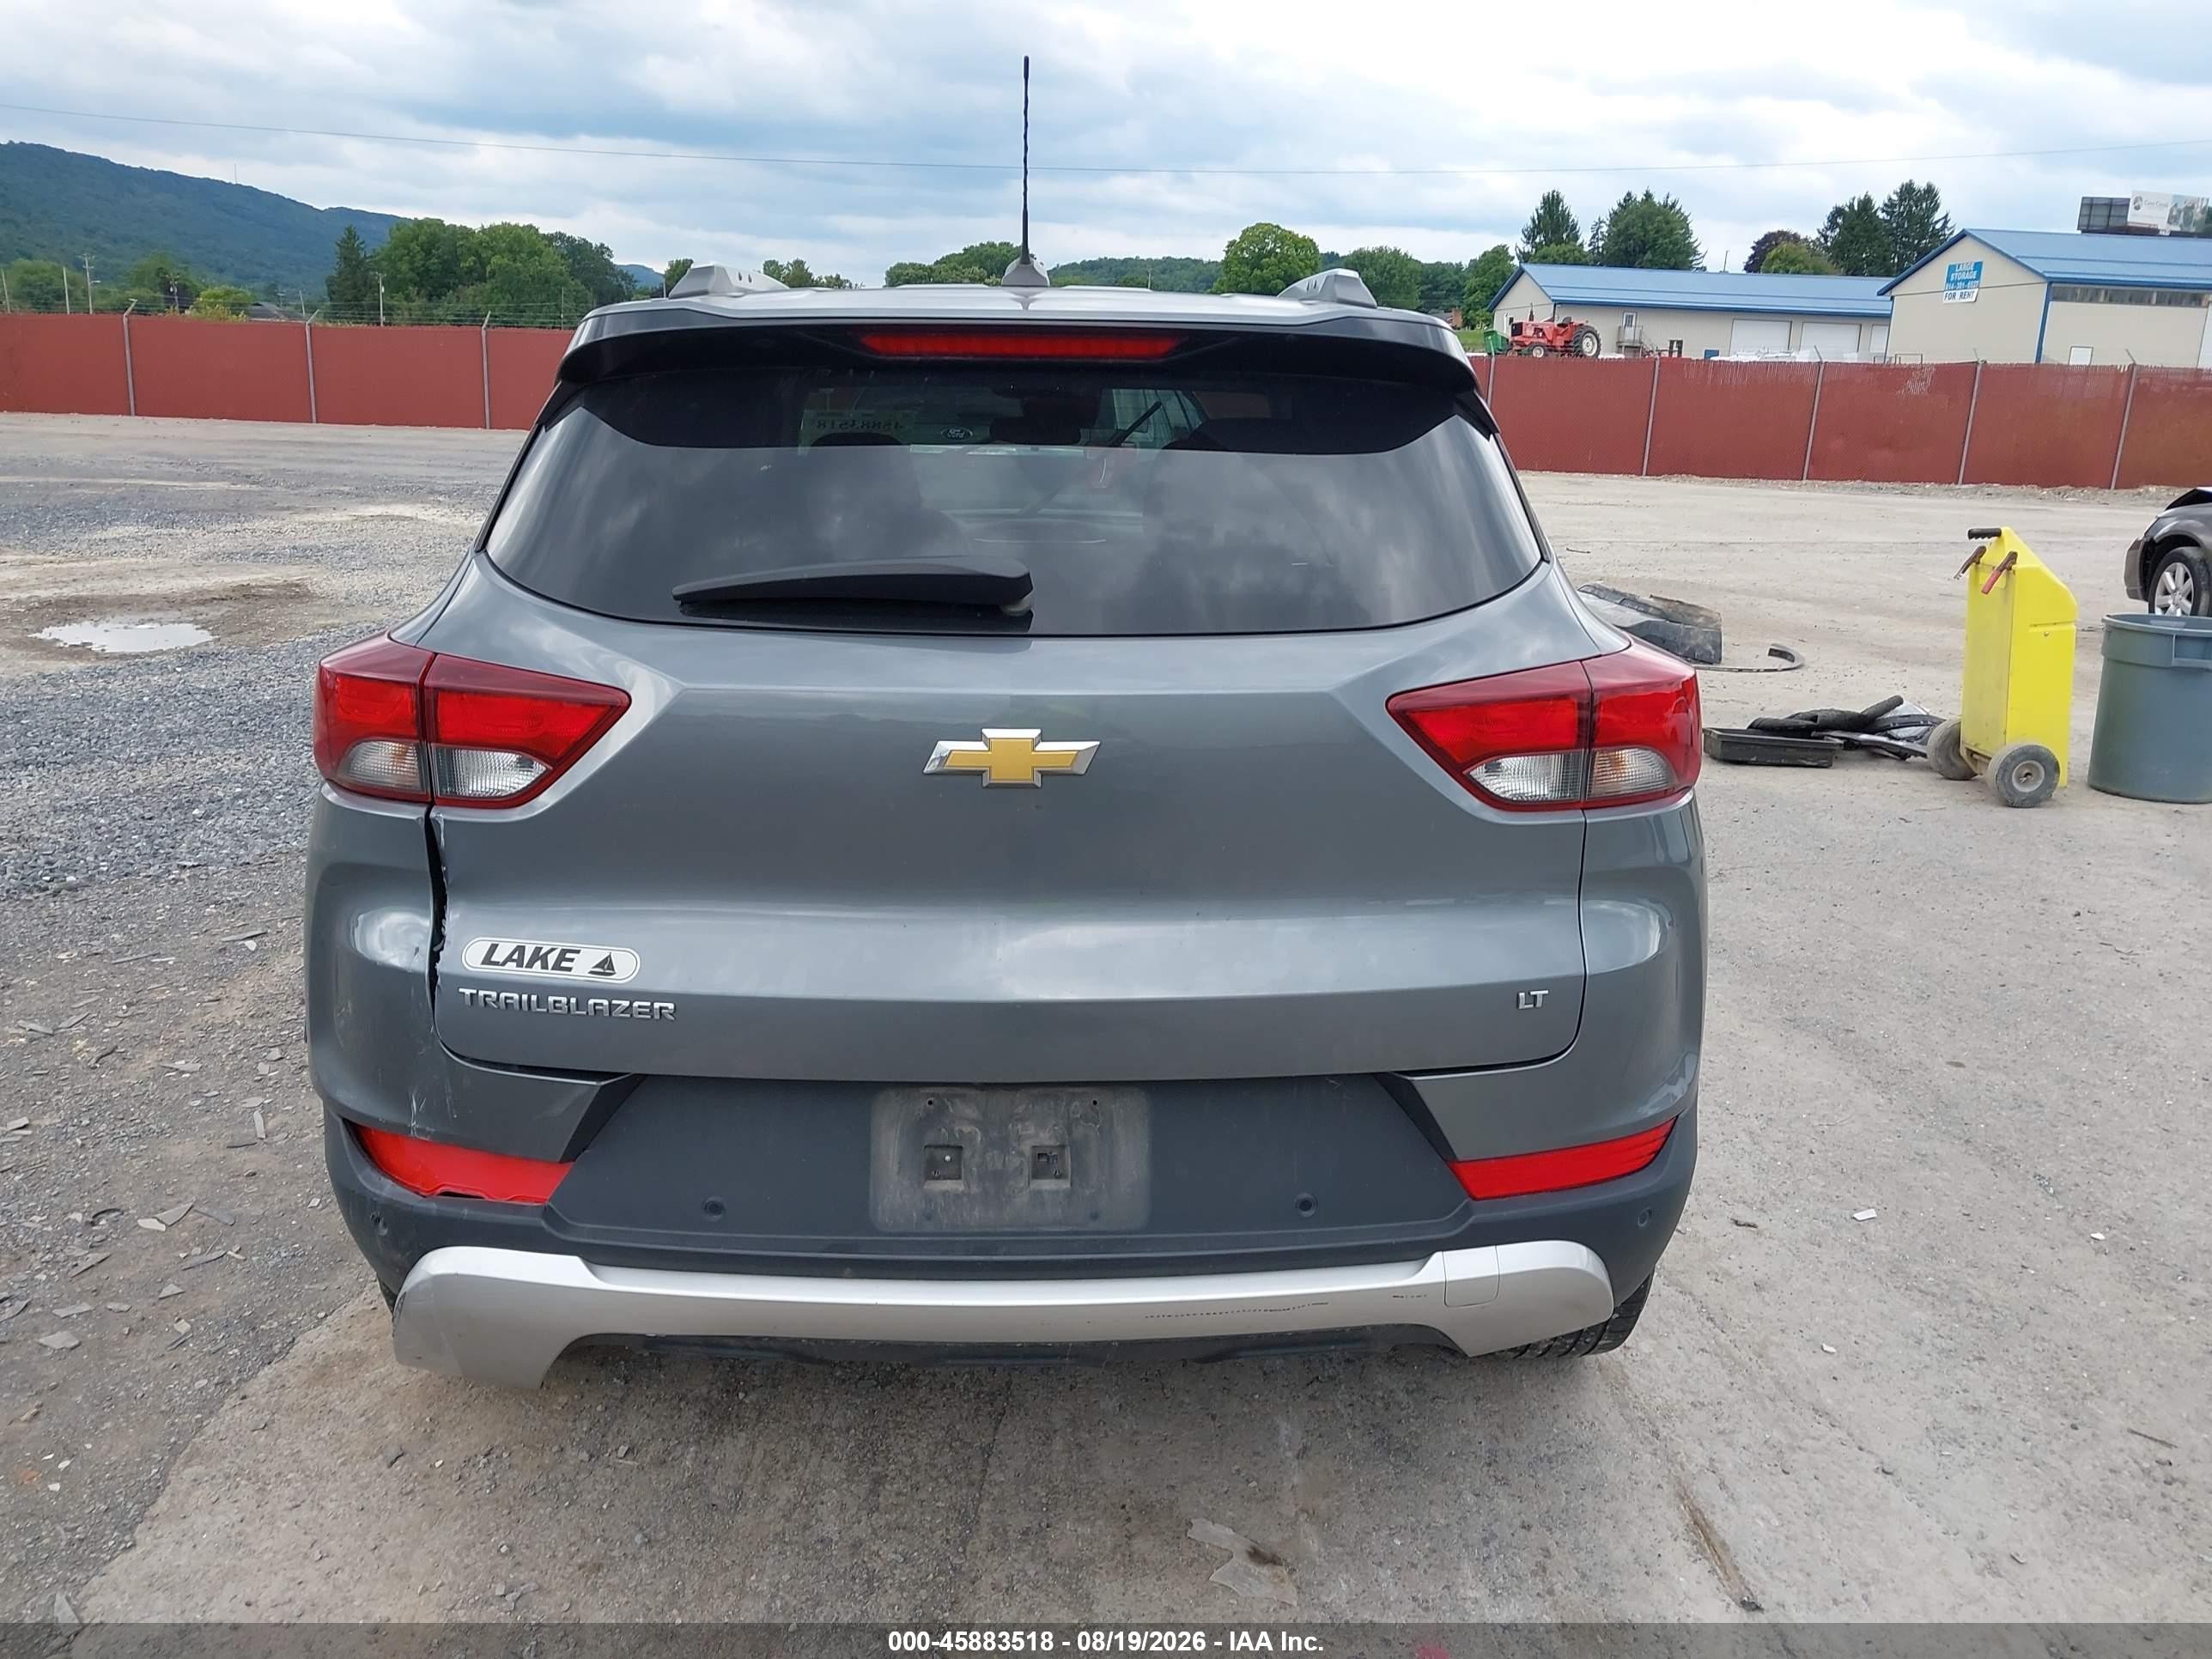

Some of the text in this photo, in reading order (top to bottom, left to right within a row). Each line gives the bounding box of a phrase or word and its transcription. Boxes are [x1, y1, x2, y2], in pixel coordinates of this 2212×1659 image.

[1955, 262, 1974, 271] LARGE
[1950, 270, 1978, 281] STORAGE
[1944, 290, 1975, 301] FOR RENT
[480, 943, 581, 973] LAKE
[458, 987, 677, 1021] TRAILBLAZER
[1517, 989, 1549, 1010] LT
